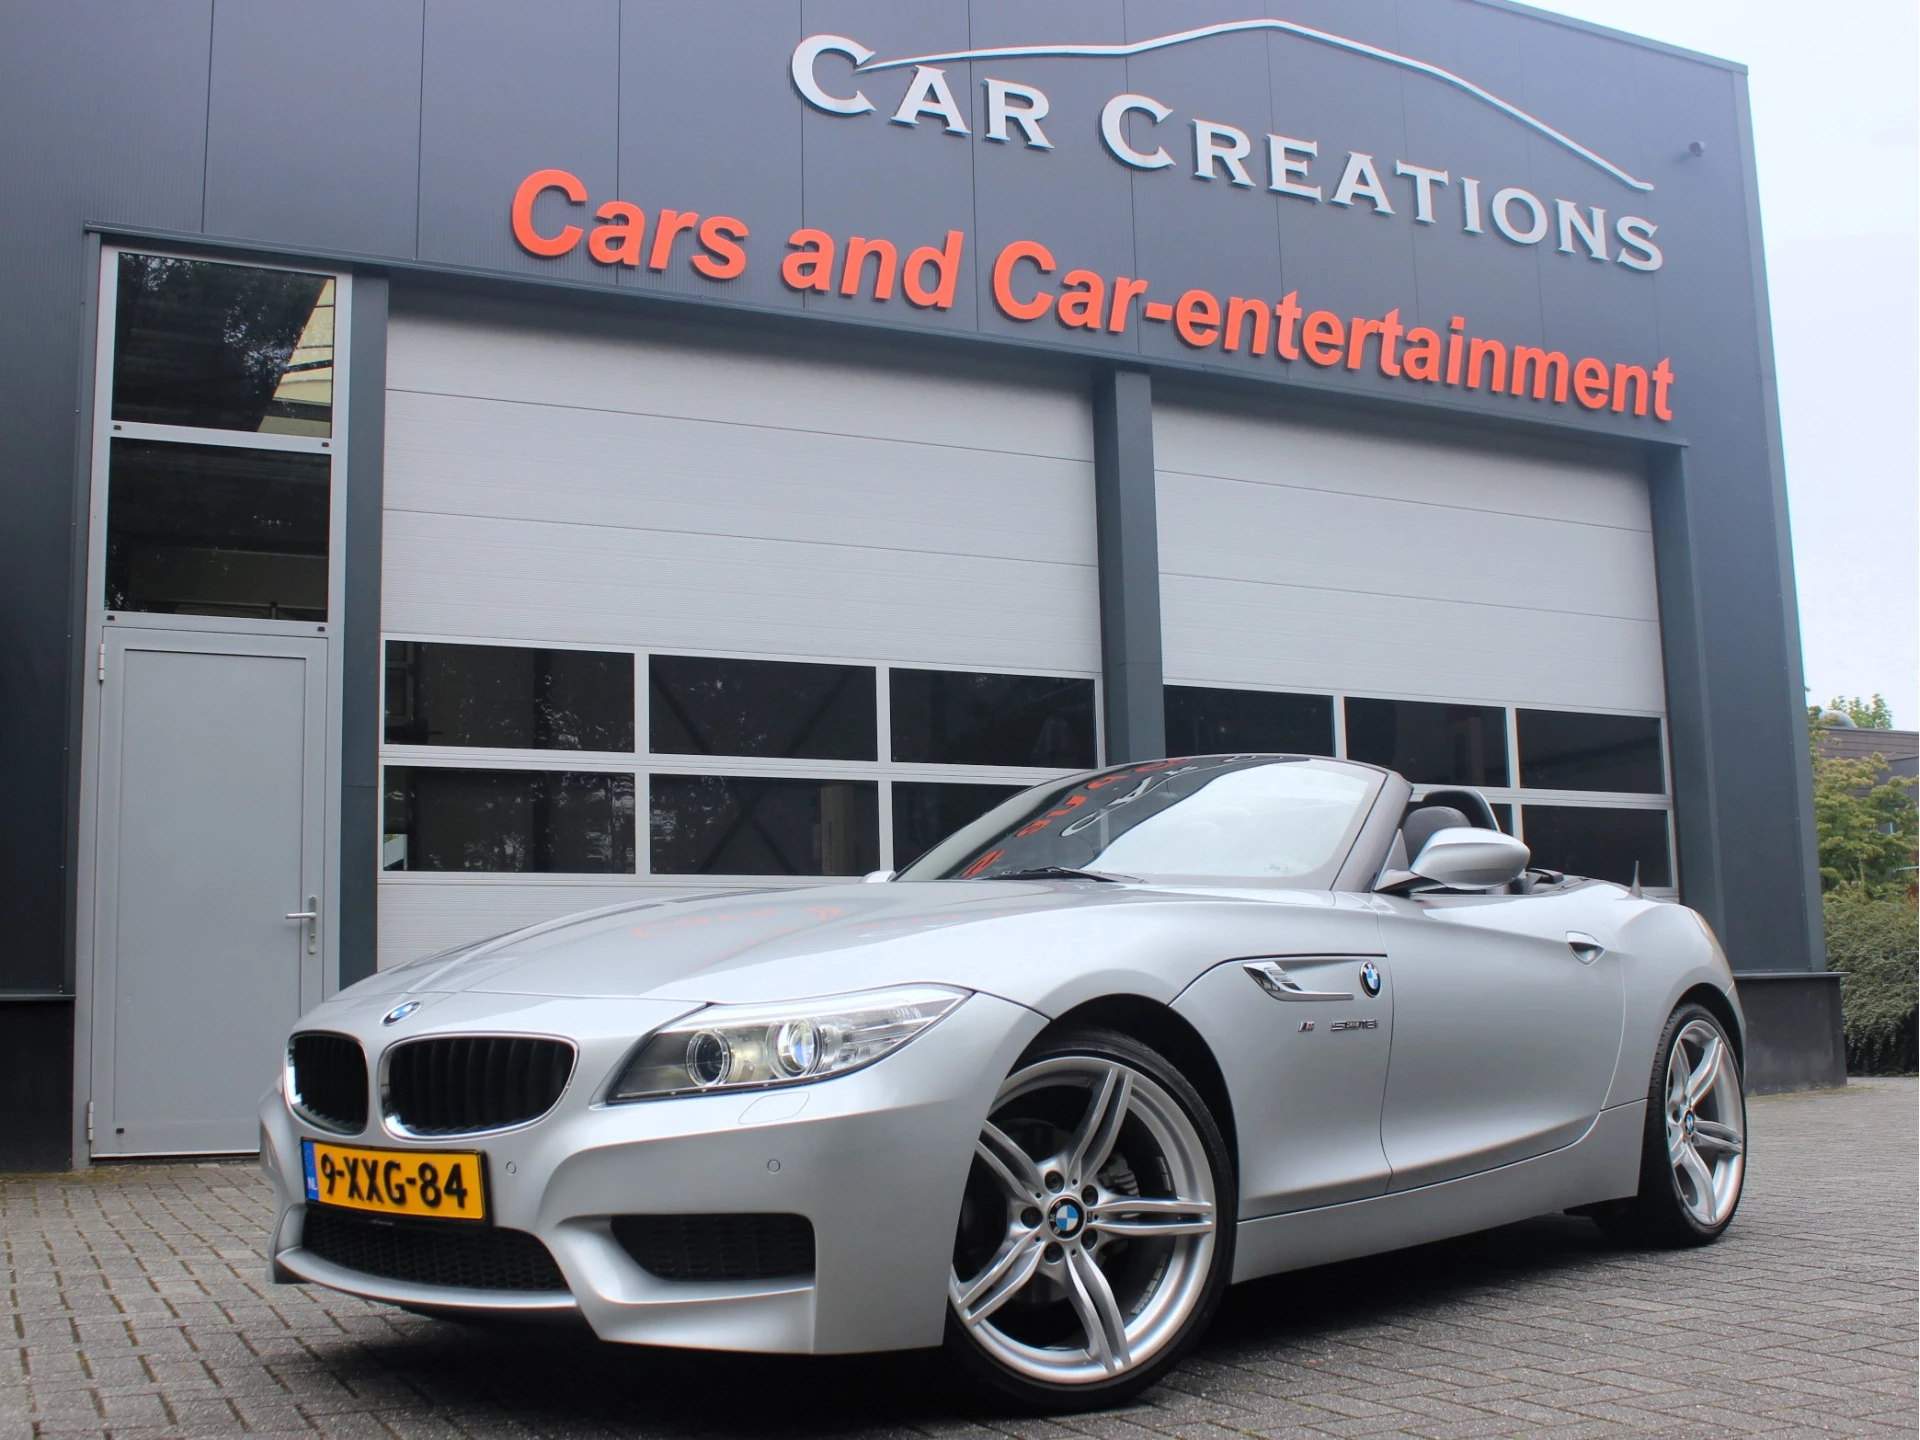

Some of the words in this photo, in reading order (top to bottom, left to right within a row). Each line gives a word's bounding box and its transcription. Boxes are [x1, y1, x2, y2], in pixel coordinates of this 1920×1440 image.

[792, 35, 1055, 149] CAR
[1101, 94, 1663, 271] CREATIONS
[512, 169, 749, 279] Cars
[782, 229, 964, 308] and
[993, 240, 1674, 420] Car-entertainment
[307, 1176, 318, 1190] NL
[321, 1153, 468, 1209] 9-XXG-84
